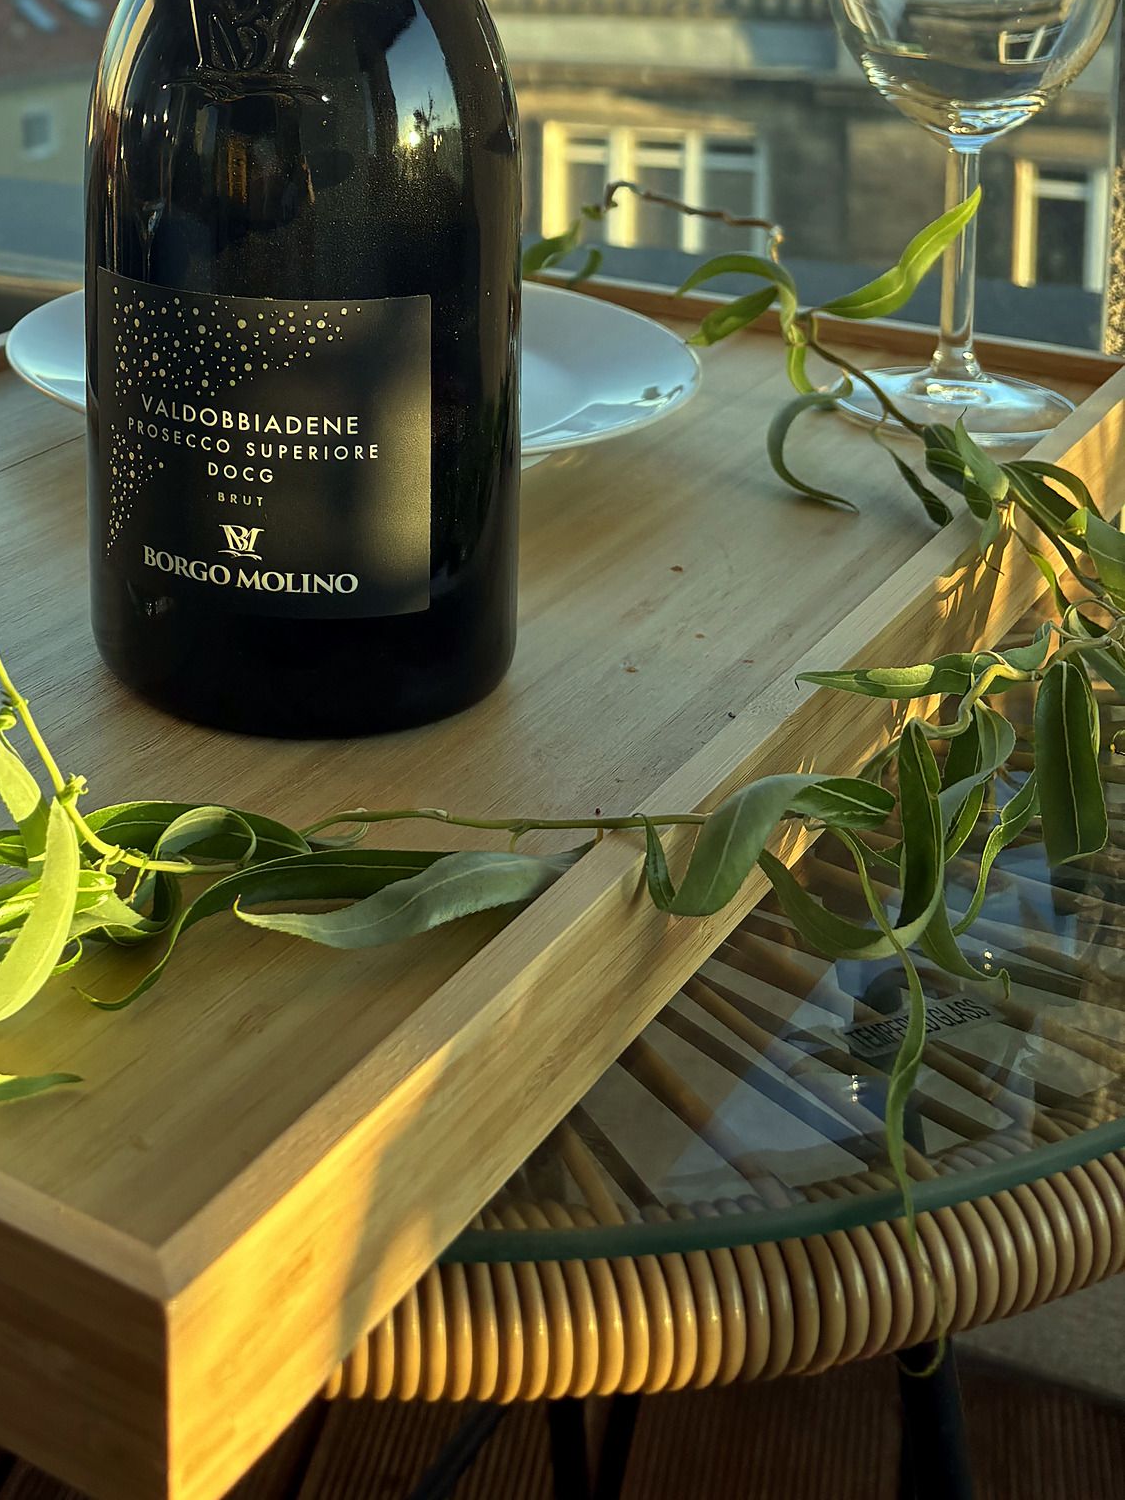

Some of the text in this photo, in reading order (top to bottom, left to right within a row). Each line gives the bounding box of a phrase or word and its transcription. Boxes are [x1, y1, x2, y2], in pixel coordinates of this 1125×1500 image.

[141, 393, 359, 436] VALDOBBIADENE
[128, 416, 379, 461] PROSECCO SUPERIORE
[207, 461, 274, 484] DOCG
[217, 491, 264, 507] BRUT
[143, 545, 360, 594] BORGO MOLINO
[931, 998, 991, 1028] GLASS
